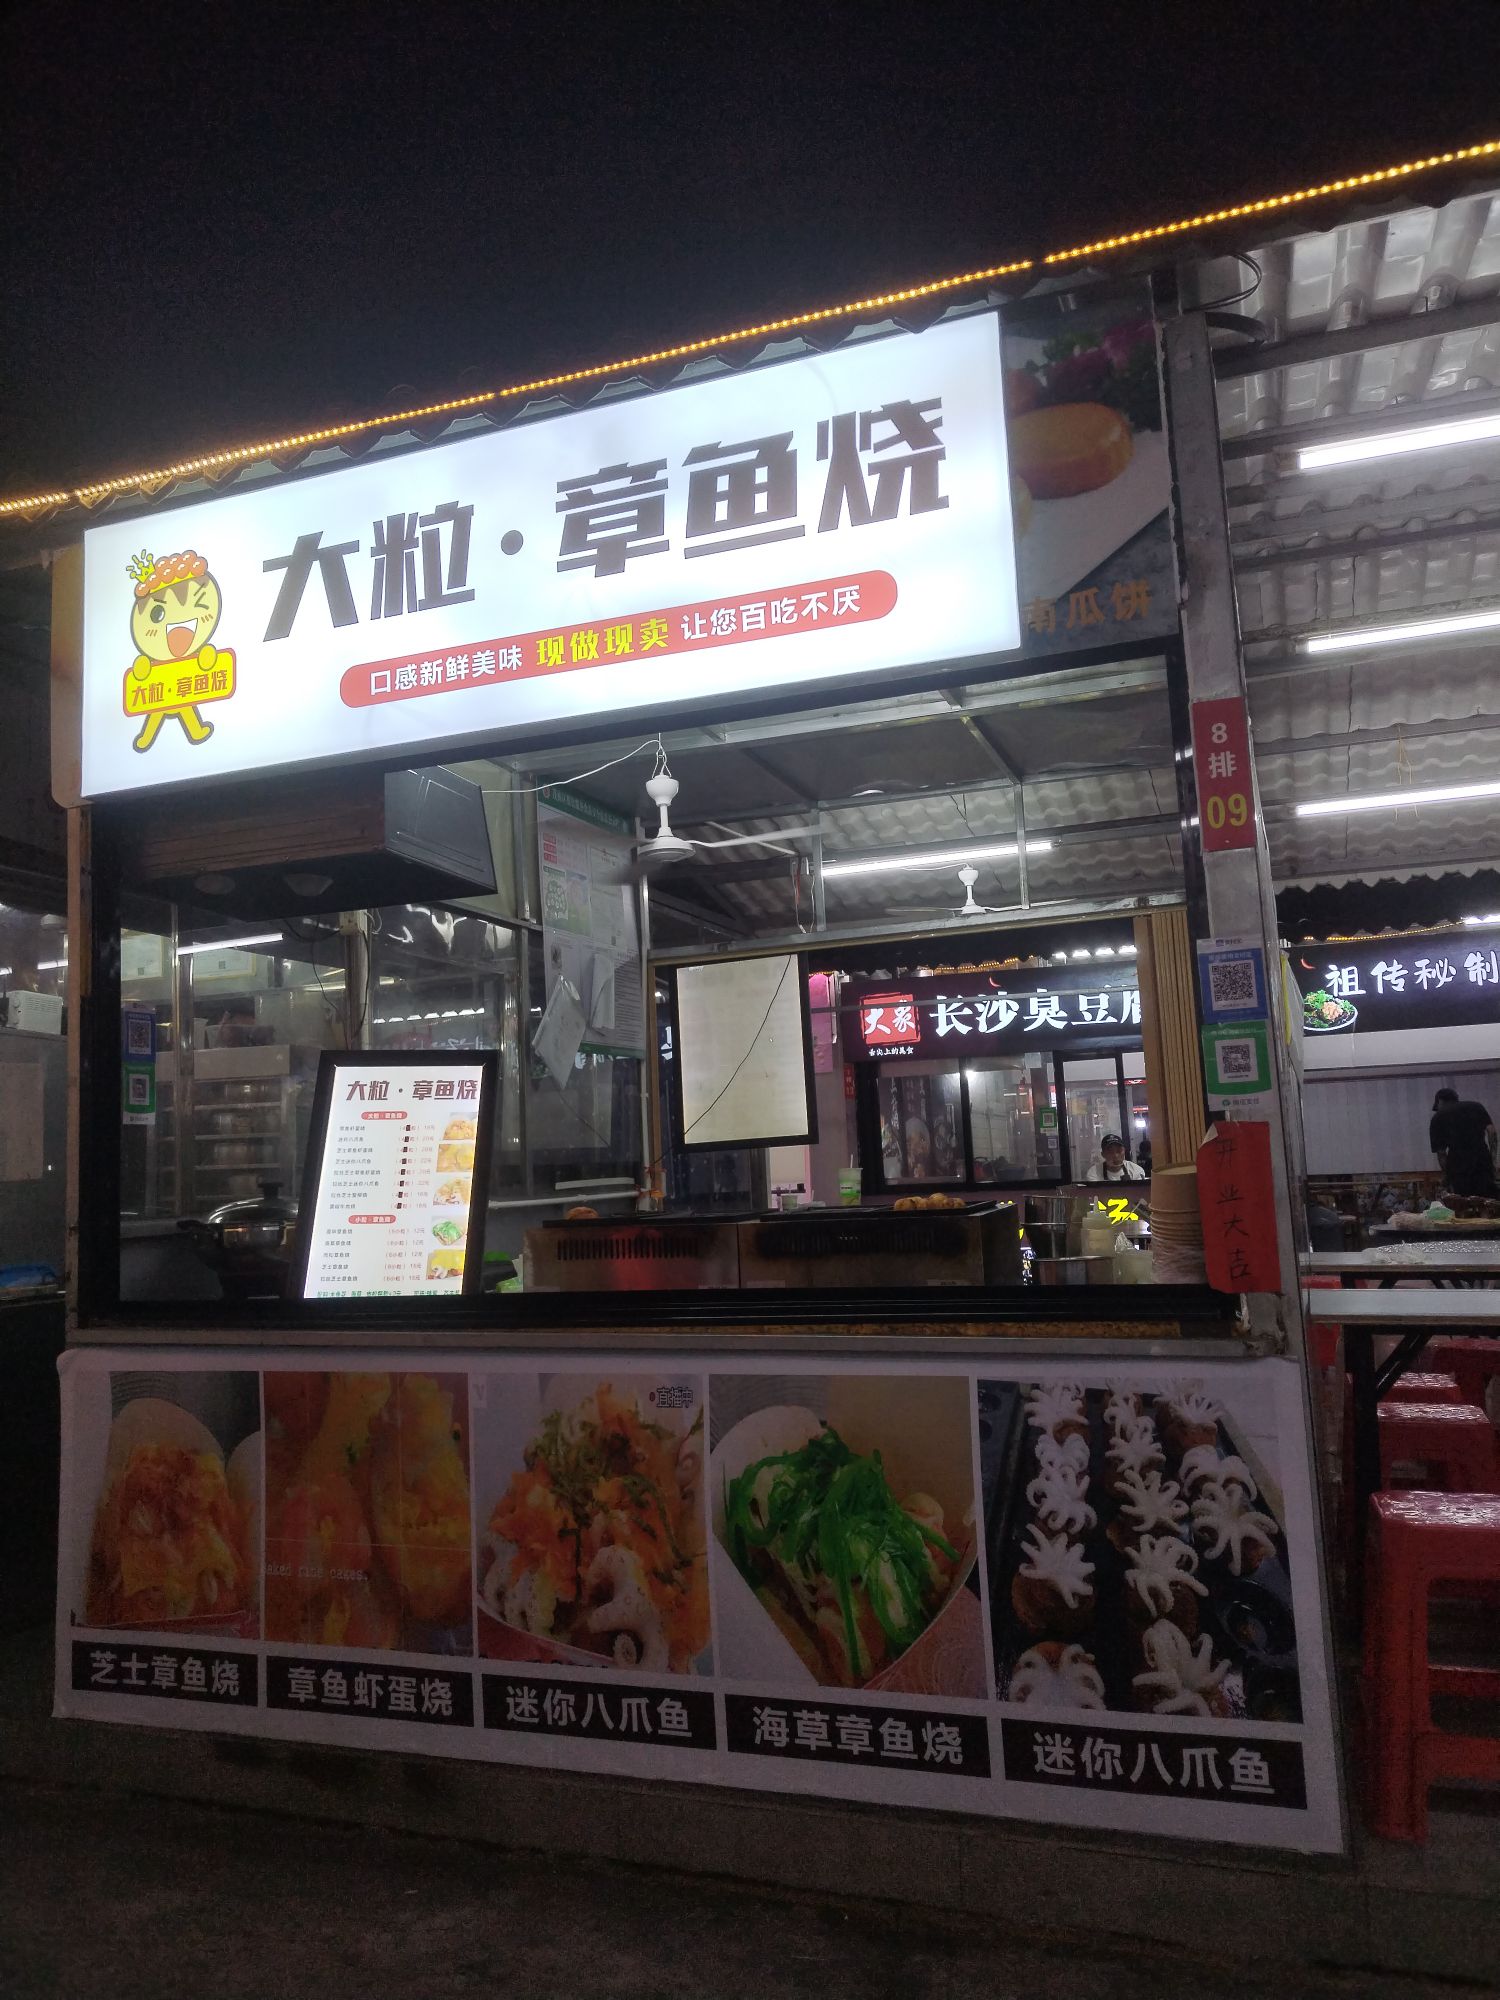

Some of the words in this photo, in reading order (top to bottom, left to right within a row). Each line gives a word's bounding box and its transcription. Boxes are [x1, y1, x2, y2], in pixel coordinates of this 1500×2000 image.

[263, 396, 949, 642] 大粒·章鱼烧
[370, 643, 523, 695] 口感新鲜美味
[536, 616, 669, 667] 现做现卖
[681, 584, 861, 640] 让您百吃不厌
[1207, 792, 1248, 829] 09
[1325, 950, 1499, 997] 祖传秘制
[1216, 1138, 1252, 1281] 开业大吉
[656, 1386, 693, 1409] 直播中
[89, 1650, 241, 1697] 芝士章鱼烧
[287, 1666, 454, 1717] 章鱼虾蛋烧
[506, 1685, 693, 1738] 迷你八爪鱼
[752, 1706, 964, 1767] 海草章鱼烧
[1033, 1732, 1276, 1796] 迷你八爪鱼
